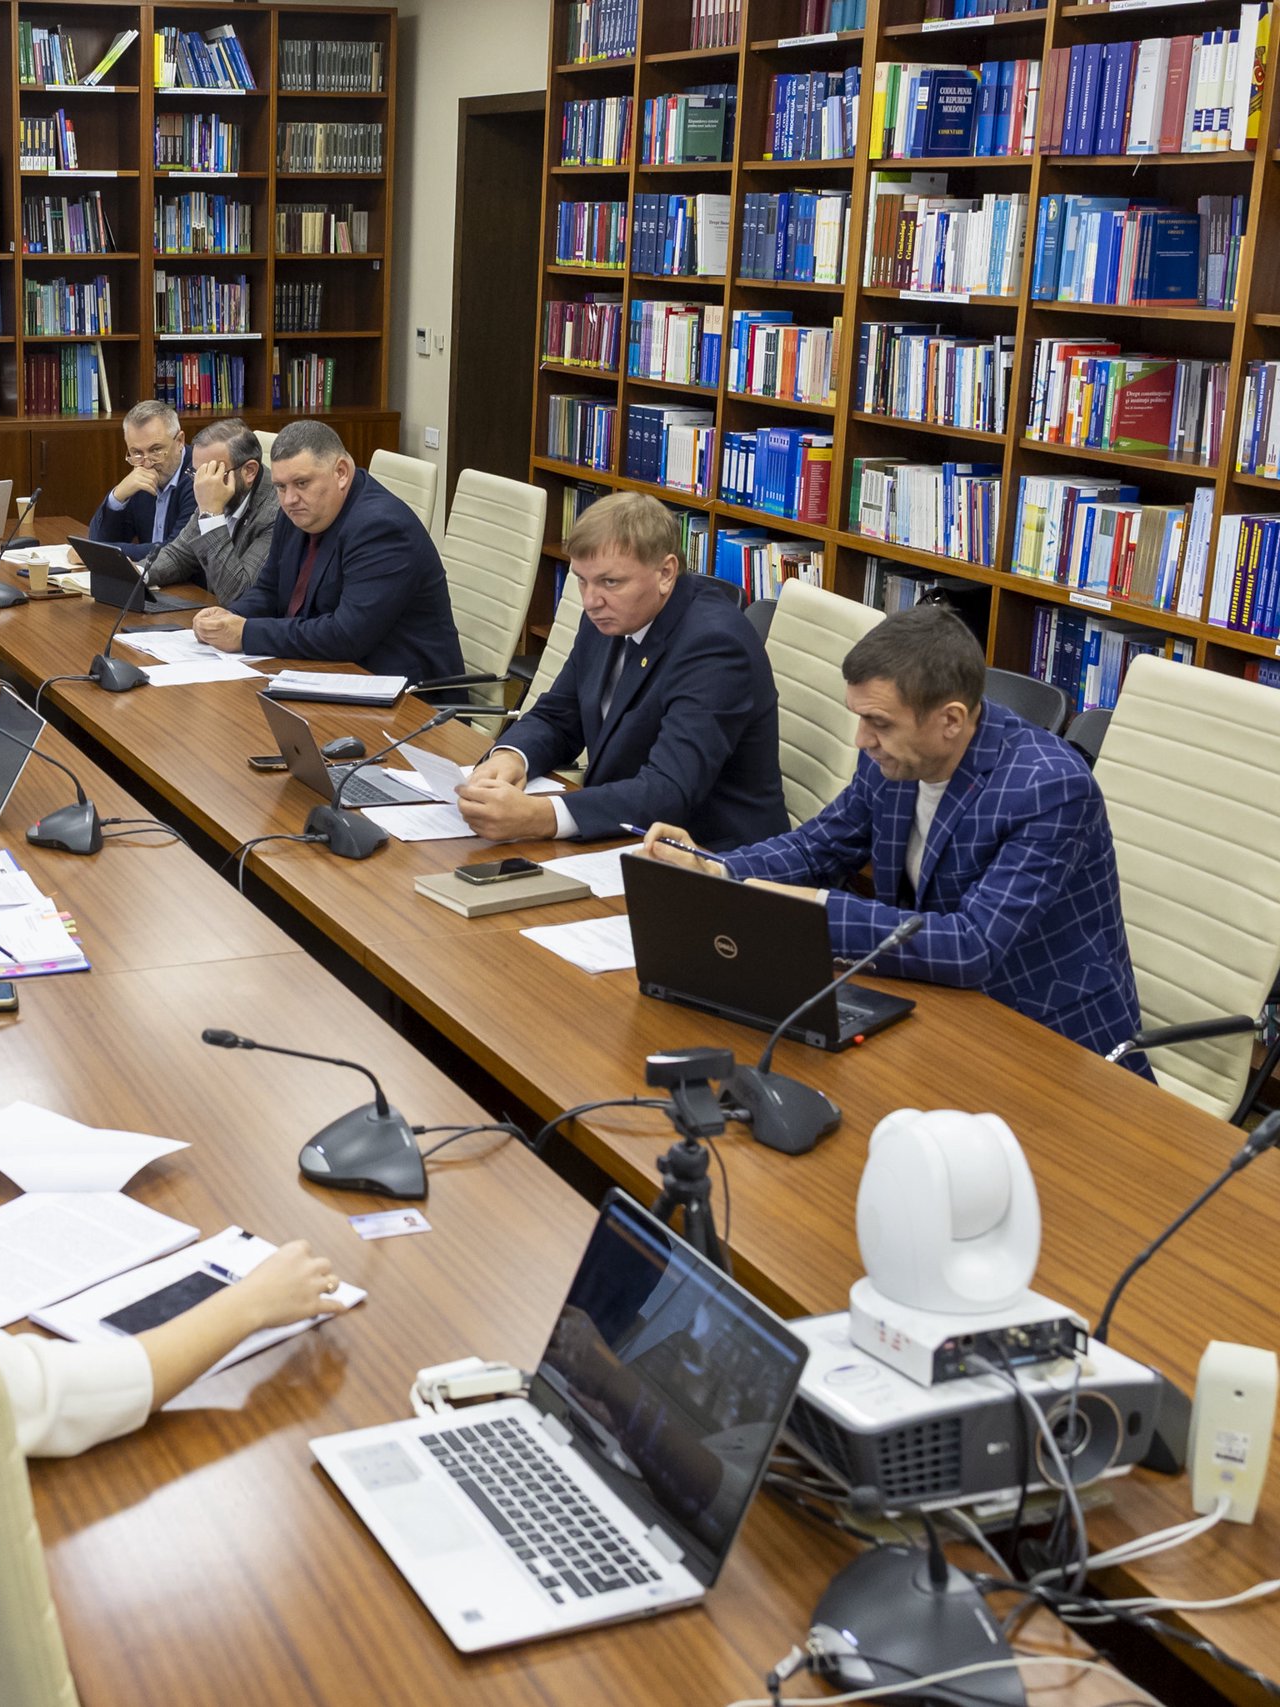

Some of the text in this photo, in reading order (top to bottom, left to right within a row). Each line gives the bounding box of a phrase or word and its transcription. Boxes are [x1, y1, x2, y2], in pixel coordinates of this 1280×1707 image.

[897, 220, 906, 259] Criminologie
[905, 220, 914, 260] Criminologie
[1230, 572, 1242, 624] JURISPRUDENȚA
[1242, 574, 1254, 626] JURISPRUDENȚA
